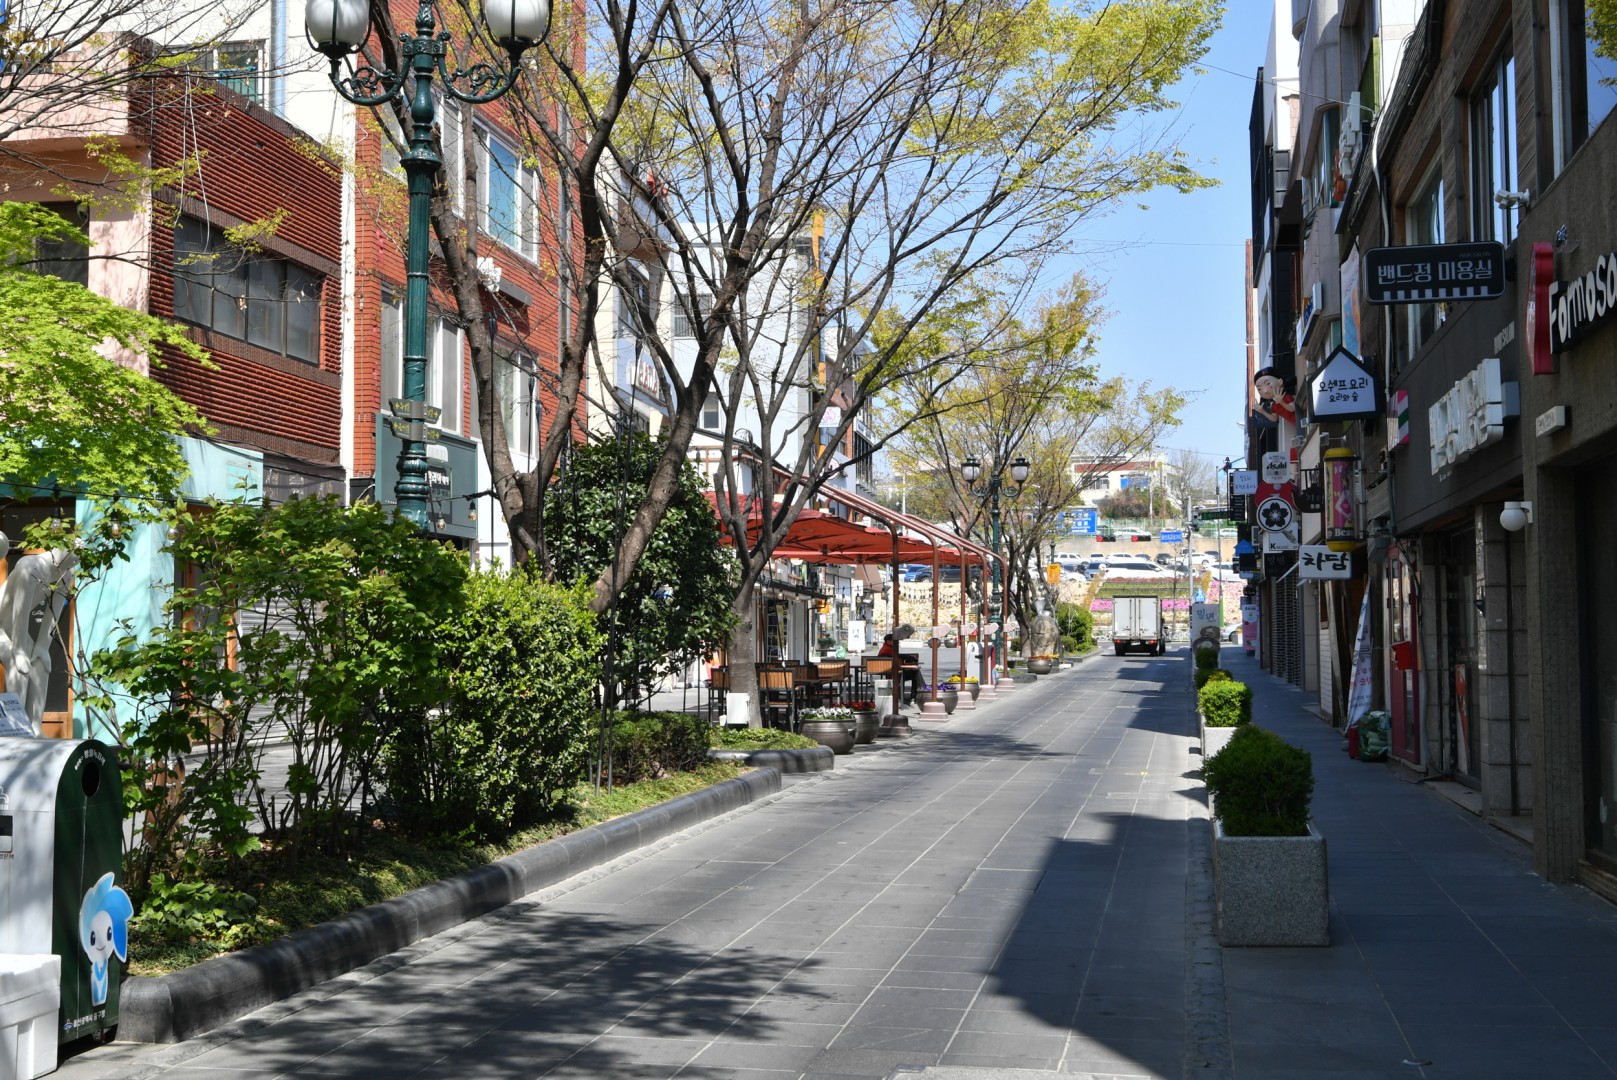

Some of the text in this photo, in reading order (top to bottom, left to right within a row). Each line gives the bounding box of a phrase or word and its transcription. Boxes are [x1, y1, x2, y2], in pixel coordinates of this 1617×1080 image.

[1378, 259, 1492, 285] 밴드정 미용실
[1329, 392, 1359, 402] 요리와 술
[1266, 462, 1287, 470] Asahi
[1302, 552, 1350, 571] 차담
